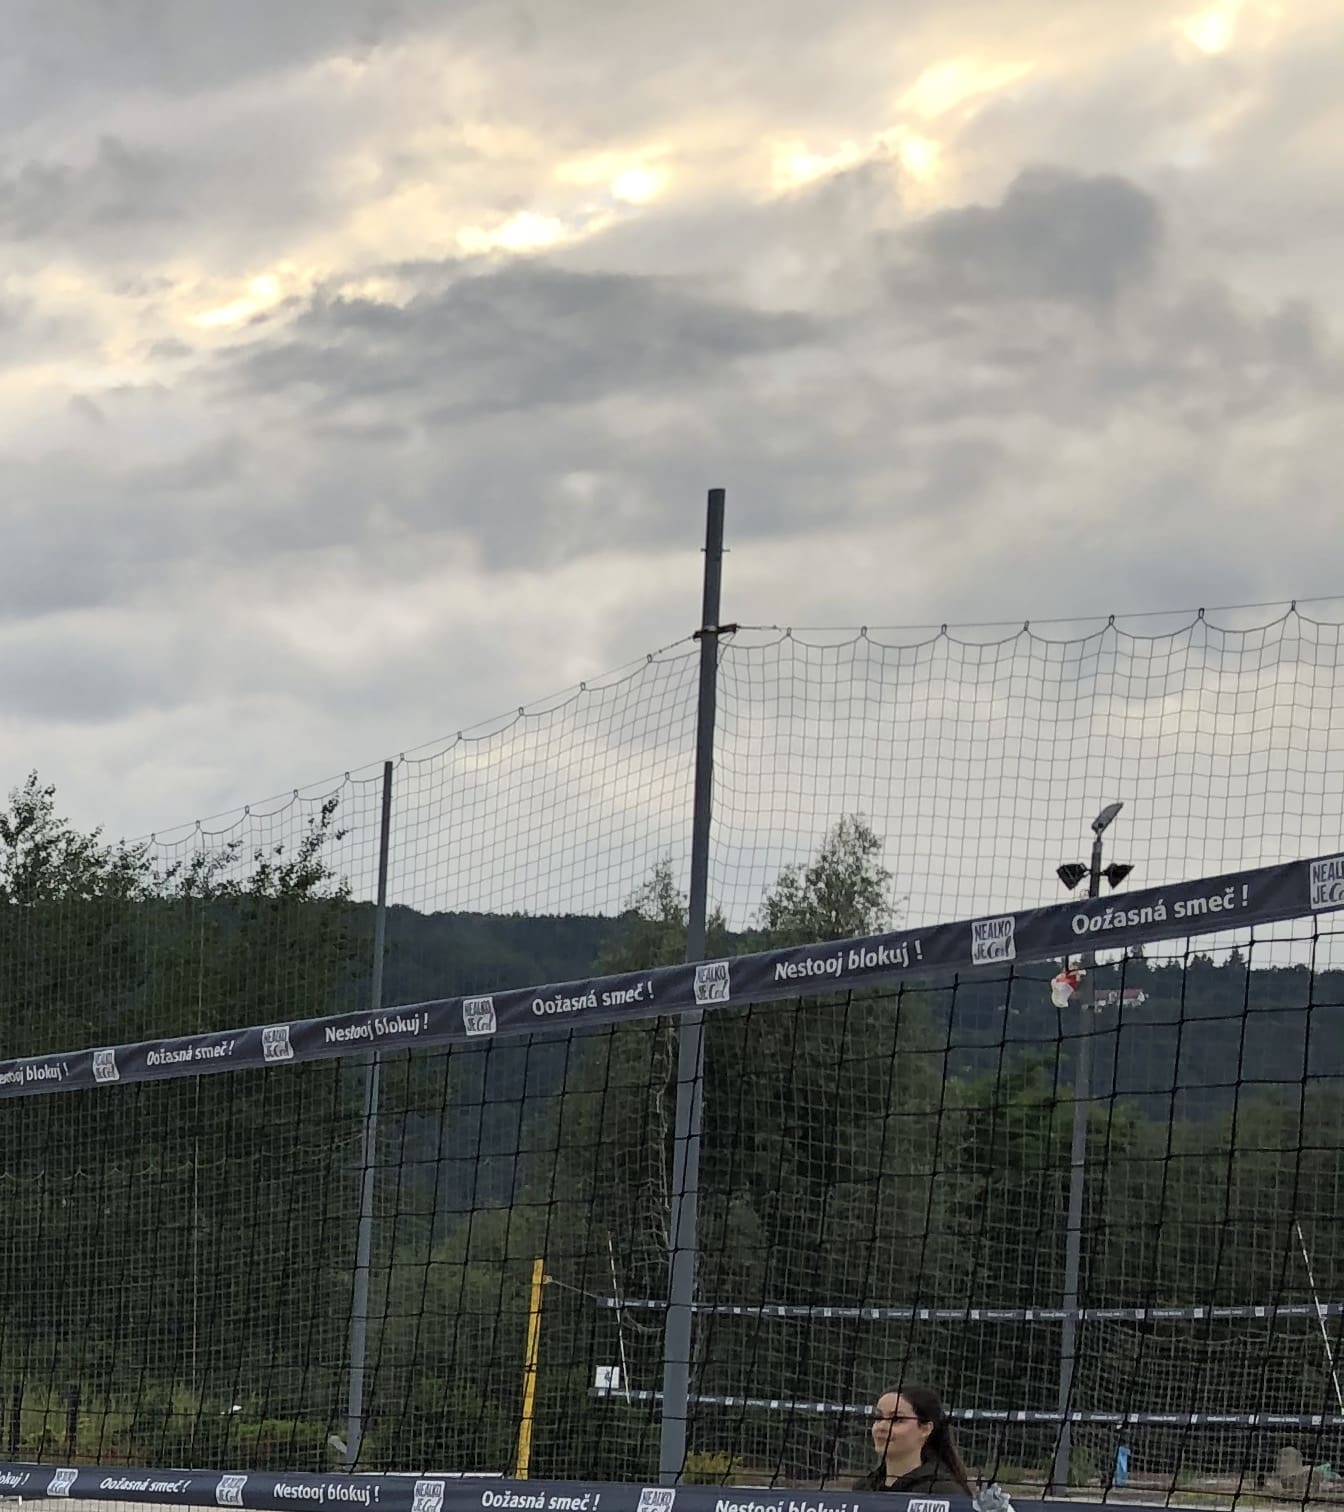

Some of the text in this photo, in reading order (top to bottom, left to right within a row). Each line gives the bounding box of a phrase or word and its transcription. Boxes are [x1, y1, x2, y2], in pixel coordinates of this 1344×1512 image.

[1313, 858, 1344, 885] NEAL
[1072, 899, 1167, 935] Oožasná
[1174, 887, 1235, 918] smeč
[974, 920, 1011, 943] NEALKO
[774, 950, 843, 981] Nestooj
[848, 941, 909, 970] blokuj
[532, 989, 598, 1016] Oožasná
[602, 984, 645, 1006] smeč
[327, 1484, 372, 1506] blokuj
[481, 1490, 545, 1510] Oožasná
[548, 1495, 590, 1511] smeč
